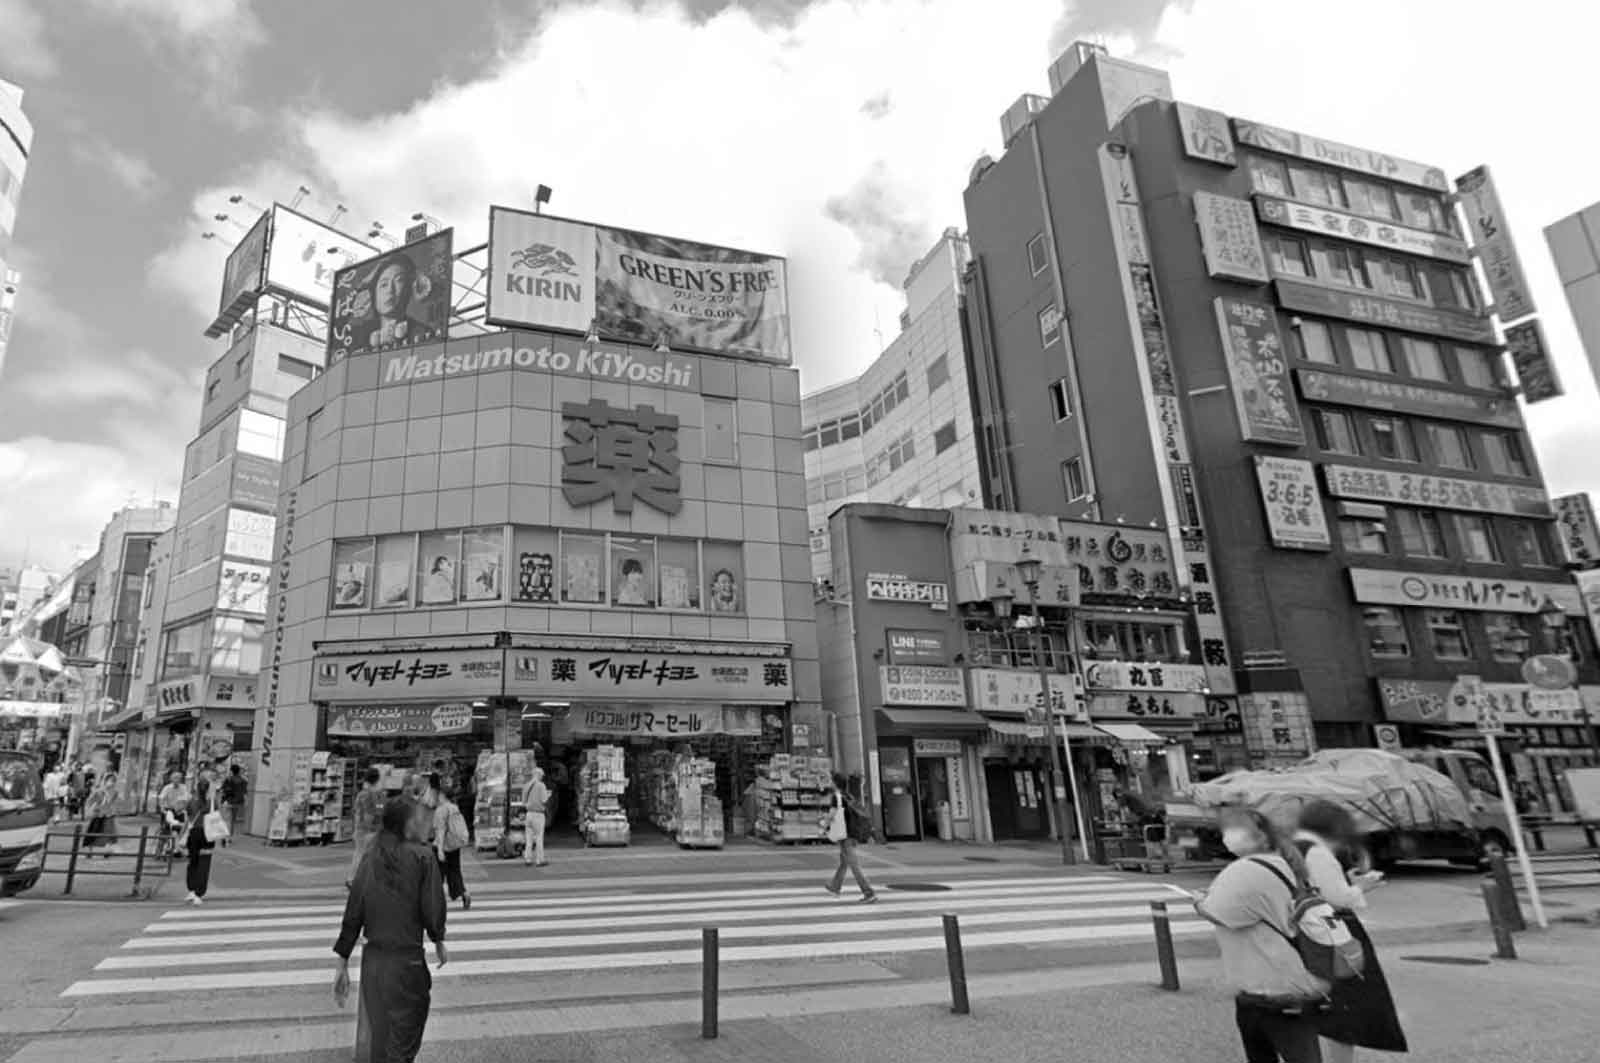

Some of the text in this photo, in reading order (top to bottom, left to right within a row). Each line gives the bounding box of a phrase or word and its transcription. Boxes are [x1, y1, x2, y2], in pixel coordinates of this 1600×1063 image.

[506, 273, 582, 303] KIRIN
[619, 254, 779, 293] GREEN'S FREE
[384, 342, 569, 384] Matsumoto
[576, 347, 693, 388] KiYoshi
[560, 399, 683, 514] 薬
[260, 596, 287, 767] Matsumoto
[345, 658, 453, 687] マツモトキヨシ
[551, 658, 577, 682] 薬
[588, 657, 700, 686] マツモトキヨシ
[763, 662, 788, 687] 薬
[629, 711, 702, 732] サマーセール
